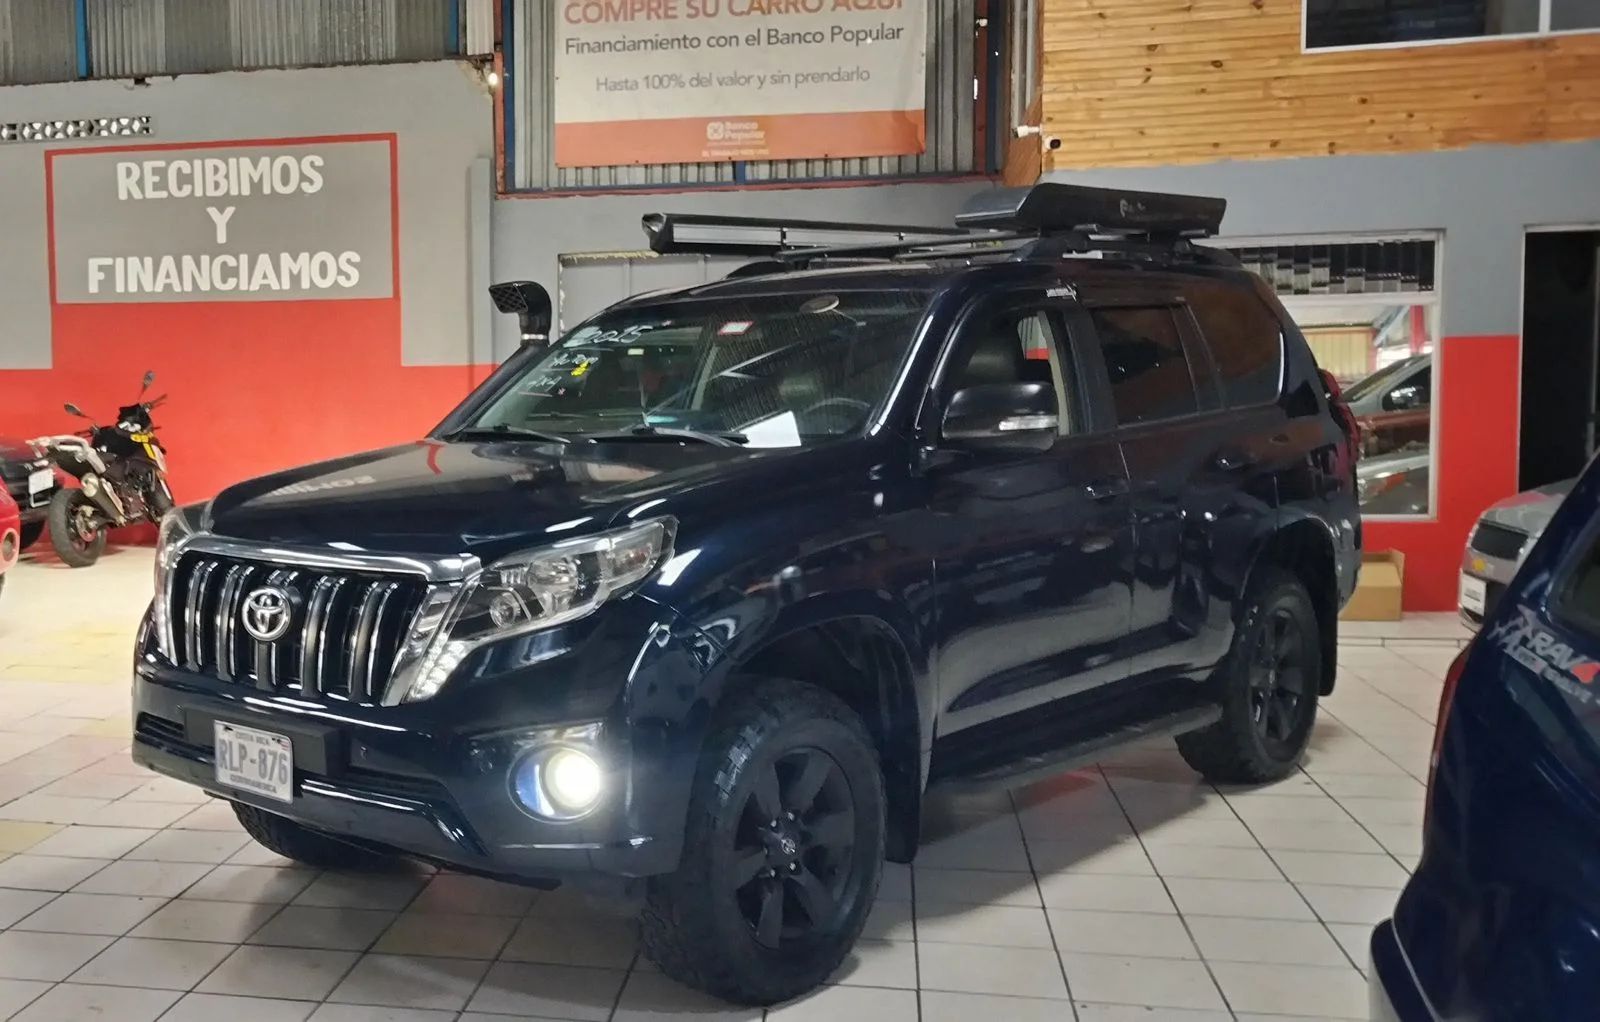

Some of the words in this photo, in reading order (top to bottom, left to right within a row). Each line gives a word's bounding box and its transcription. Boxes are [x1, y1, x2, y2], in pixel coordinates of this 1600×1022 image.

[564, 0, 678, 24] COMPRE
[686, 0, 720, 19] SU
[727, 0, 823, 16] CARRO
[565, 34, 701, 54] Financiamiento
[706, 34, 739, 48] con
[745, 28, 761, 46] el
[767, 28, 824, 46] Banco
[830, 22, 904, 47] Popular
[596, 76, 639, 92] Hasta
[644, 73, 685, 90] 100%
[689, 72, 712, 88] del
[716, 70, 754, 87] valor
[757, 74, 767, 90] y
[770, 69, 790, 85] sin
[795, 66, 871, 89] prendarlo
[116, 155, 325, 201] RECIBIMOS
[206, 206, 236, 245] Y
[88, 250, 361, 294] FINANCIAMOS
[219, 738, 288, 785] RLP-876
